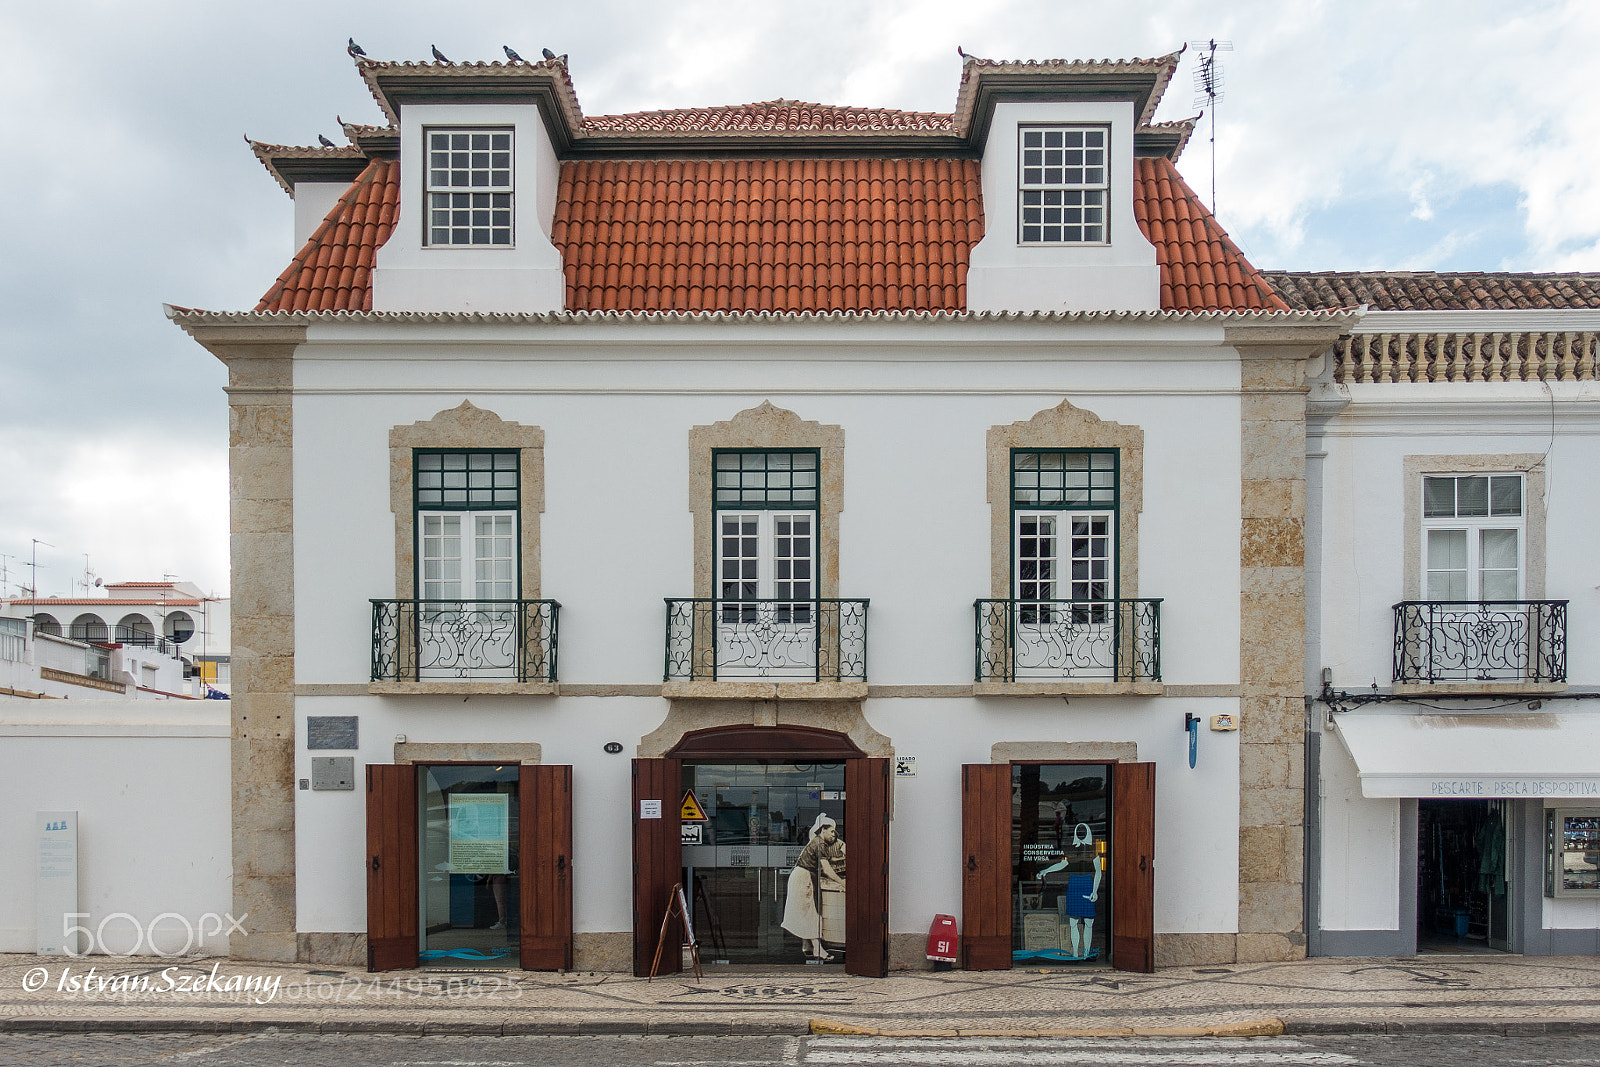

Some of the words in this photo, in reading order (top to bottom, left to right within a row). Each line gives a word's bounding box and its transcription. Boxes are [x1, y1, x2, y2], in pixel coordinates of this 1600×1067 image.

[1431, 781, 1483, 795] PESCARTE
[1494, 781, 1528, 795] PESCA
[1532, 781, 1598, 795] DESPORTIVA
